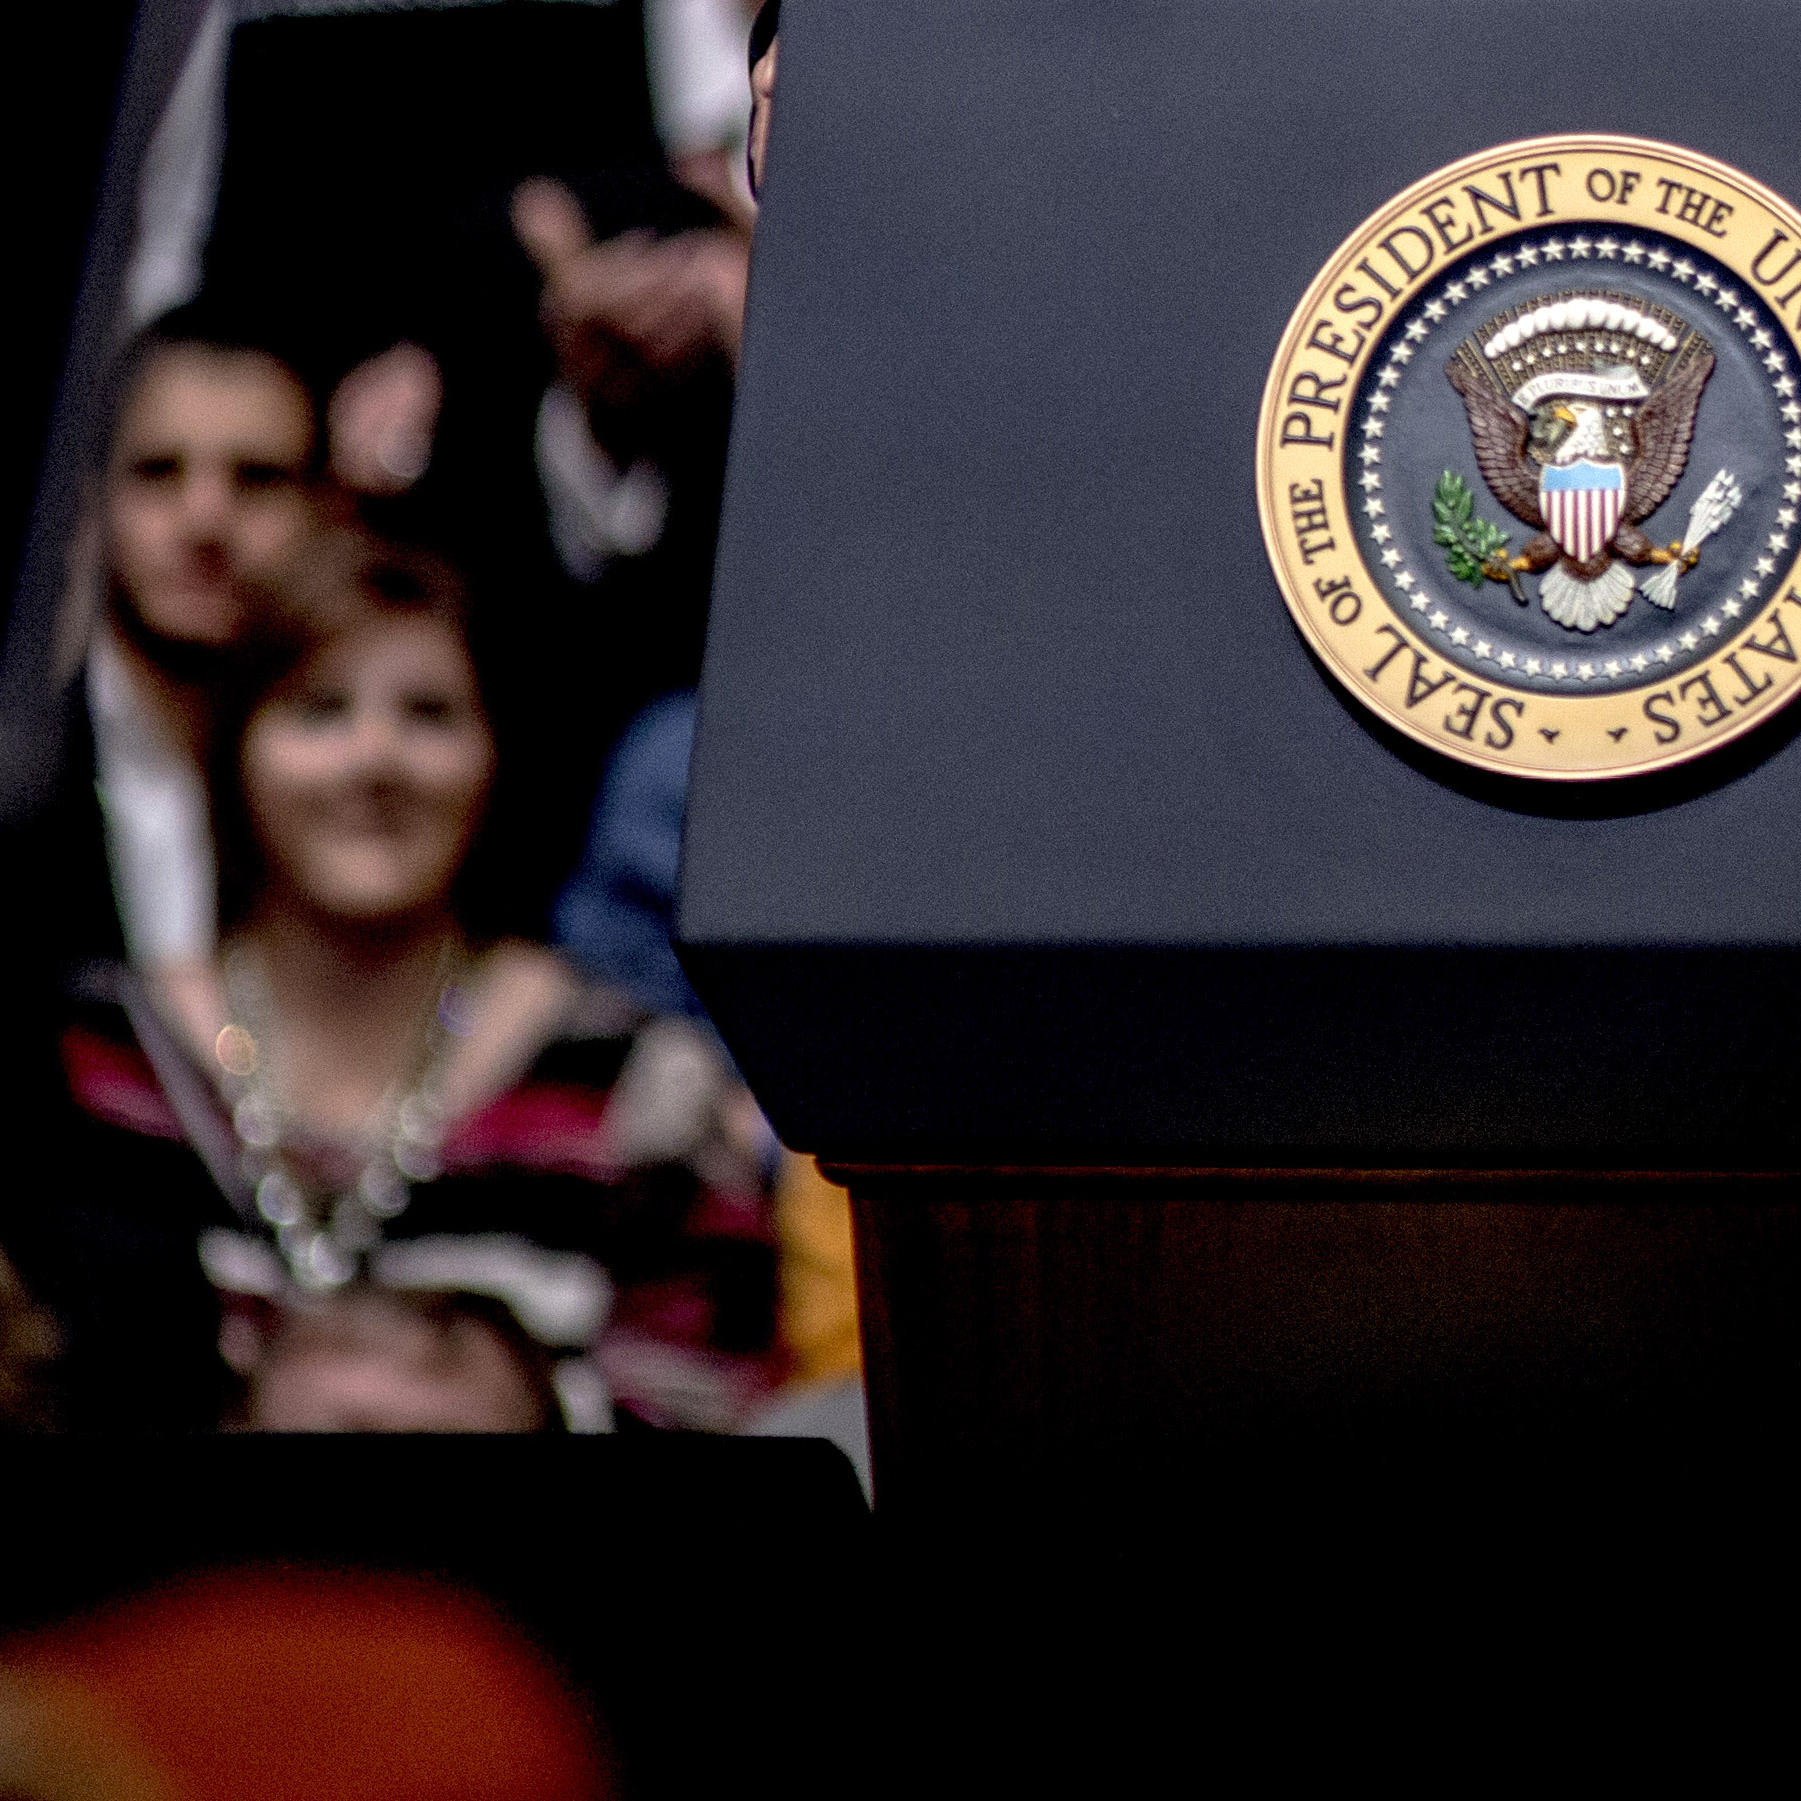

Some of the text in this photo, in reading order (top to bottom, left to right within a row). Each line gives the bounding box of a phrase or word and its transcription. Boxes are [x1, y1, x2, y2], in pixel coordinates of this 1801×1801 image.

[1586, 168, 1641, 206] OF
[1656, 177, 1736, 239] THE
[1282, 163, 1560, 452] PRESIDENT
[1291, 478, 1338, 561] THE
[1313, 577, 1362, 627] OF
[1363, 624, 1525, 750] SEAL
